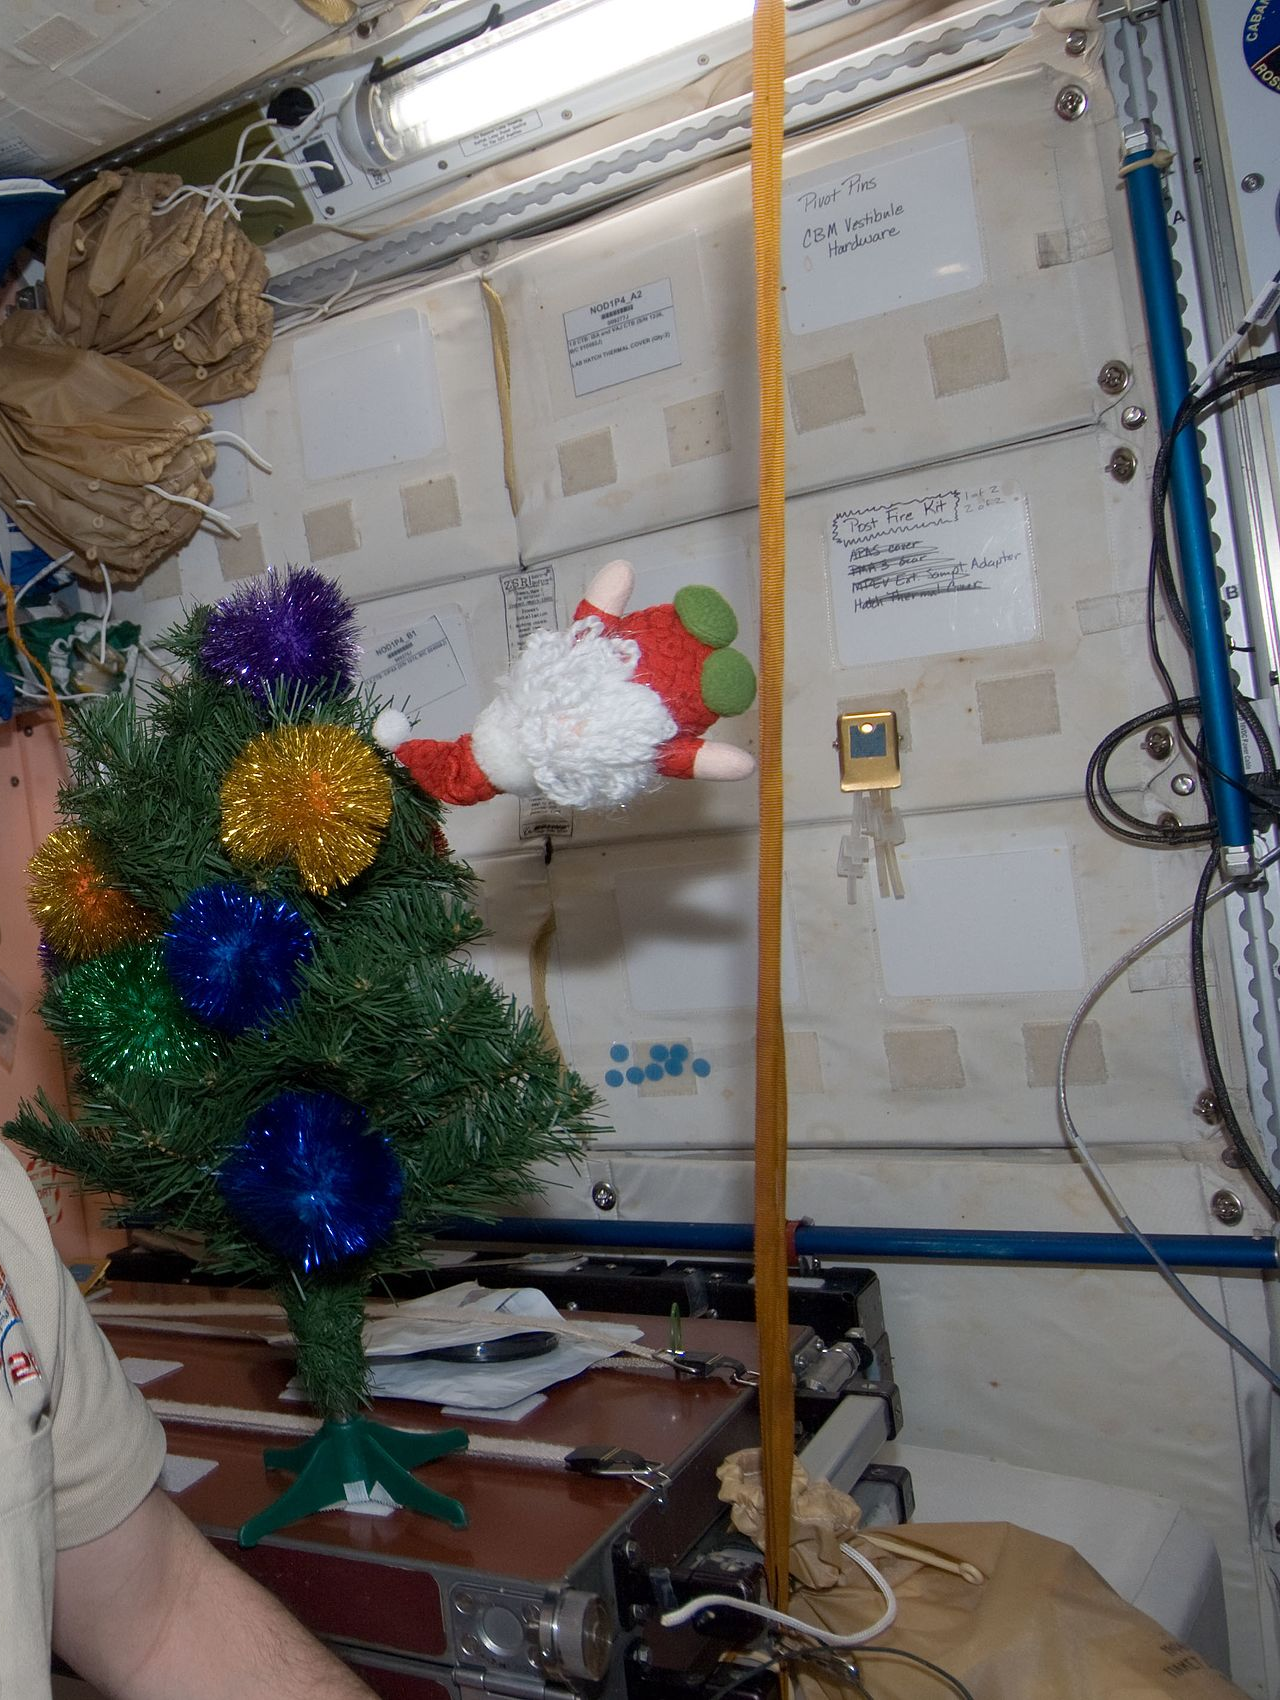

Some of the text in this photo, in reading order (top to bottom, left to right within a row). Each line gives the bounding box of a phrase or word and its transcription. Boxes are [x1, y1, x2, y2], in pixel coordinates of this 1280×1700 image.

[797, 173, 877, 212] Pivot Pins
[802, 202, 904, 248] CBM Vestibule
[1173, 210, 1186, 224] A
[828, 226, 900, 258] Hardware
[603, 345, 629, 358] THERMAL
[630, 338, 651, 349] COVER
[843, 499, 947, 534] Post Fire Kit
[1225, 585, 1239, 600] B
